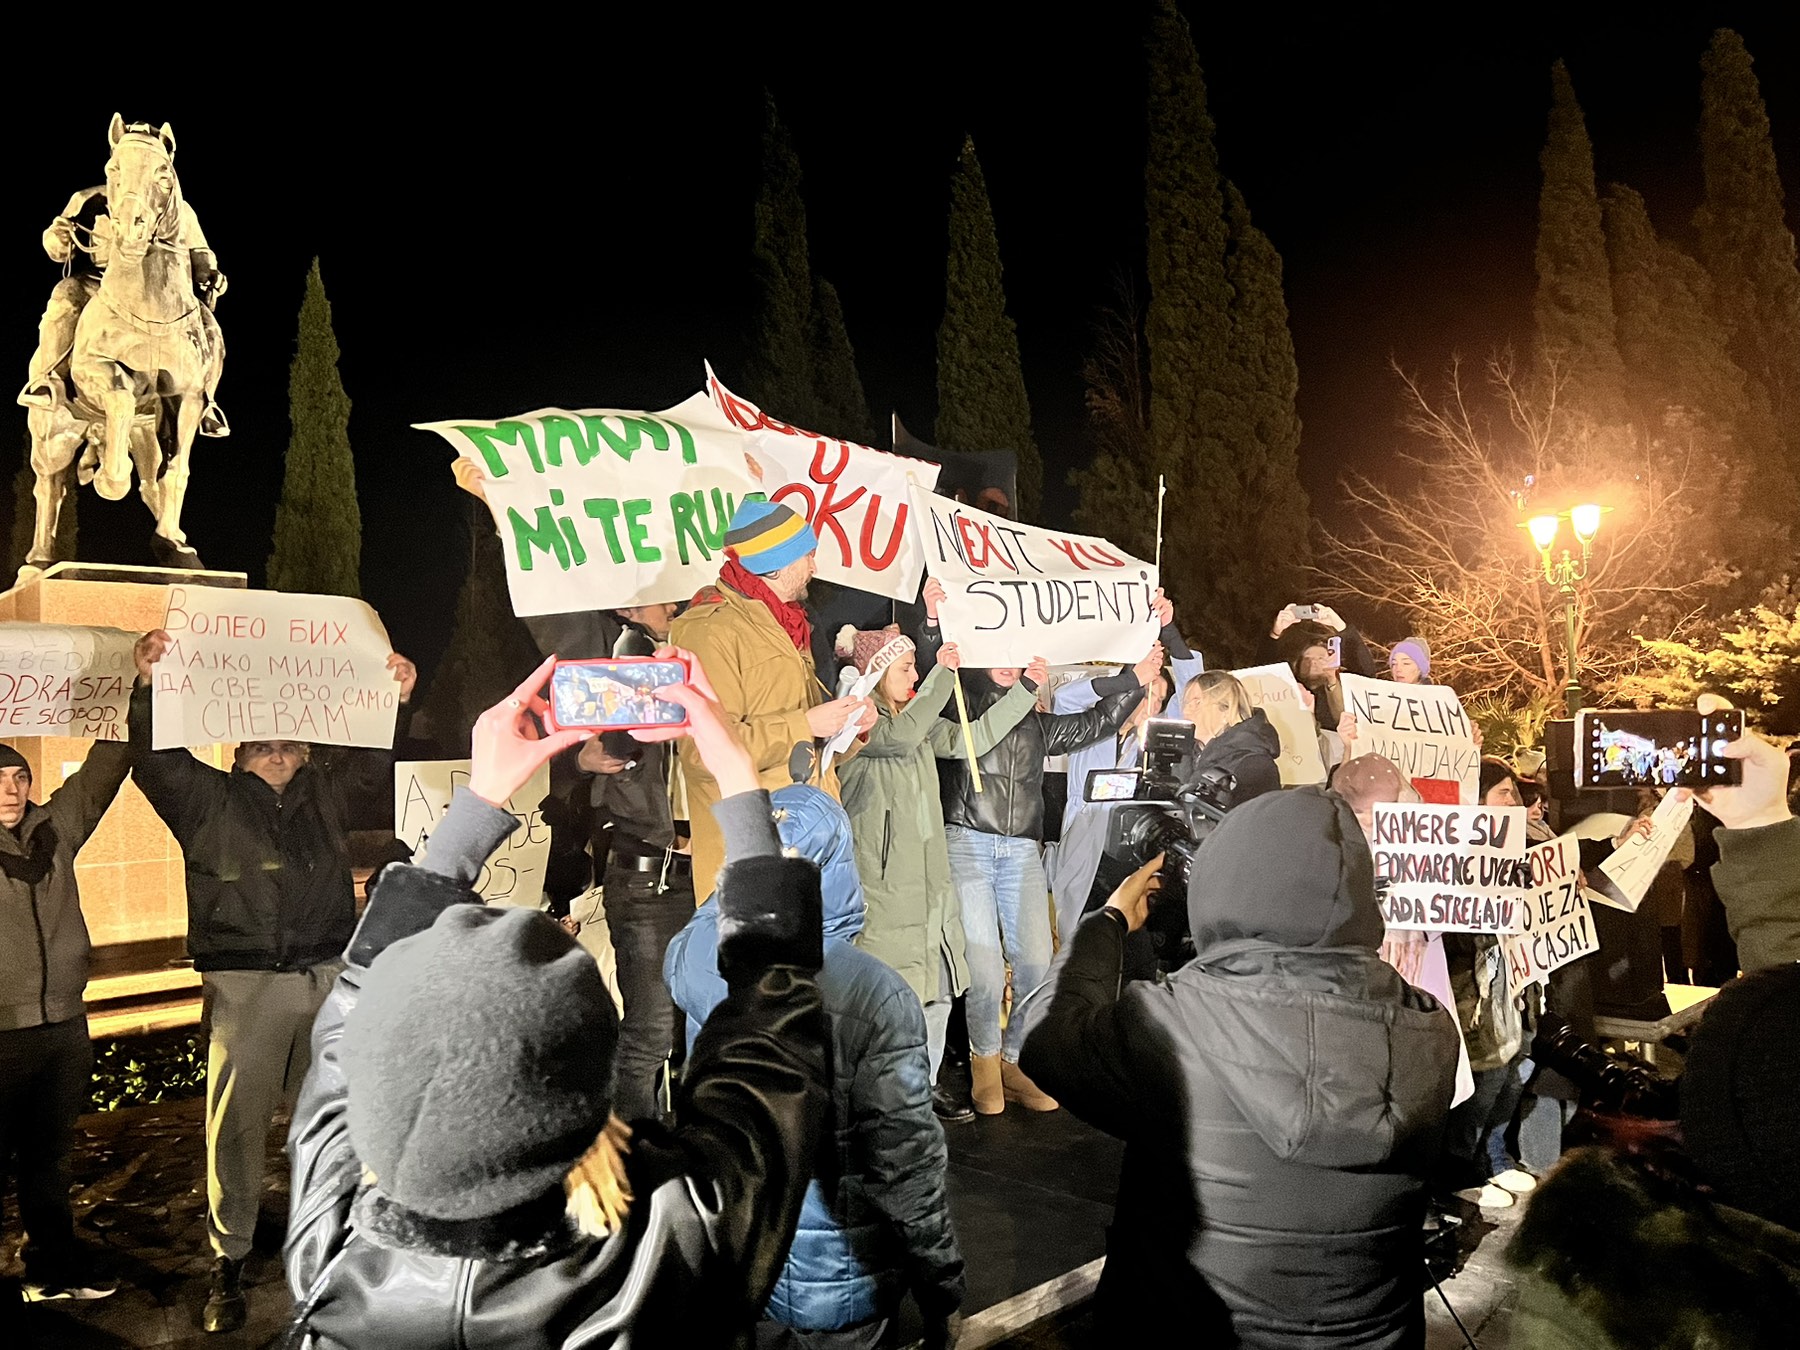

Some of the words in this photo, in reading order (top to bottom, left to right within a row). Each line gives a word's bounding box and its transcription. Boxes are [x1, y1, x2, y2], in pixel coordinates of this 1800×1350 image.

[455, 414, 698, 478] MAKNI
[809, 440, 850, 484] U
[583, 498, 663, 565] TE
[669, 487, 768, 566] RU
[1047, 537, 1126, 571] YU
[289, 619, 348, 645] БИХ
[157, 673, 196, 699] ДА
[211, 677, 264, 699] СВЕ
[280, 682, 331, 701] ОВО
[343, 686, 393, 711] САМО
[1350, 690, 1385, 725] NE
[82, 722, 121, 740] MIR
[202, 700, 351, 741] СНЕВАМ
[1469, 812, 1510, 849] SU
